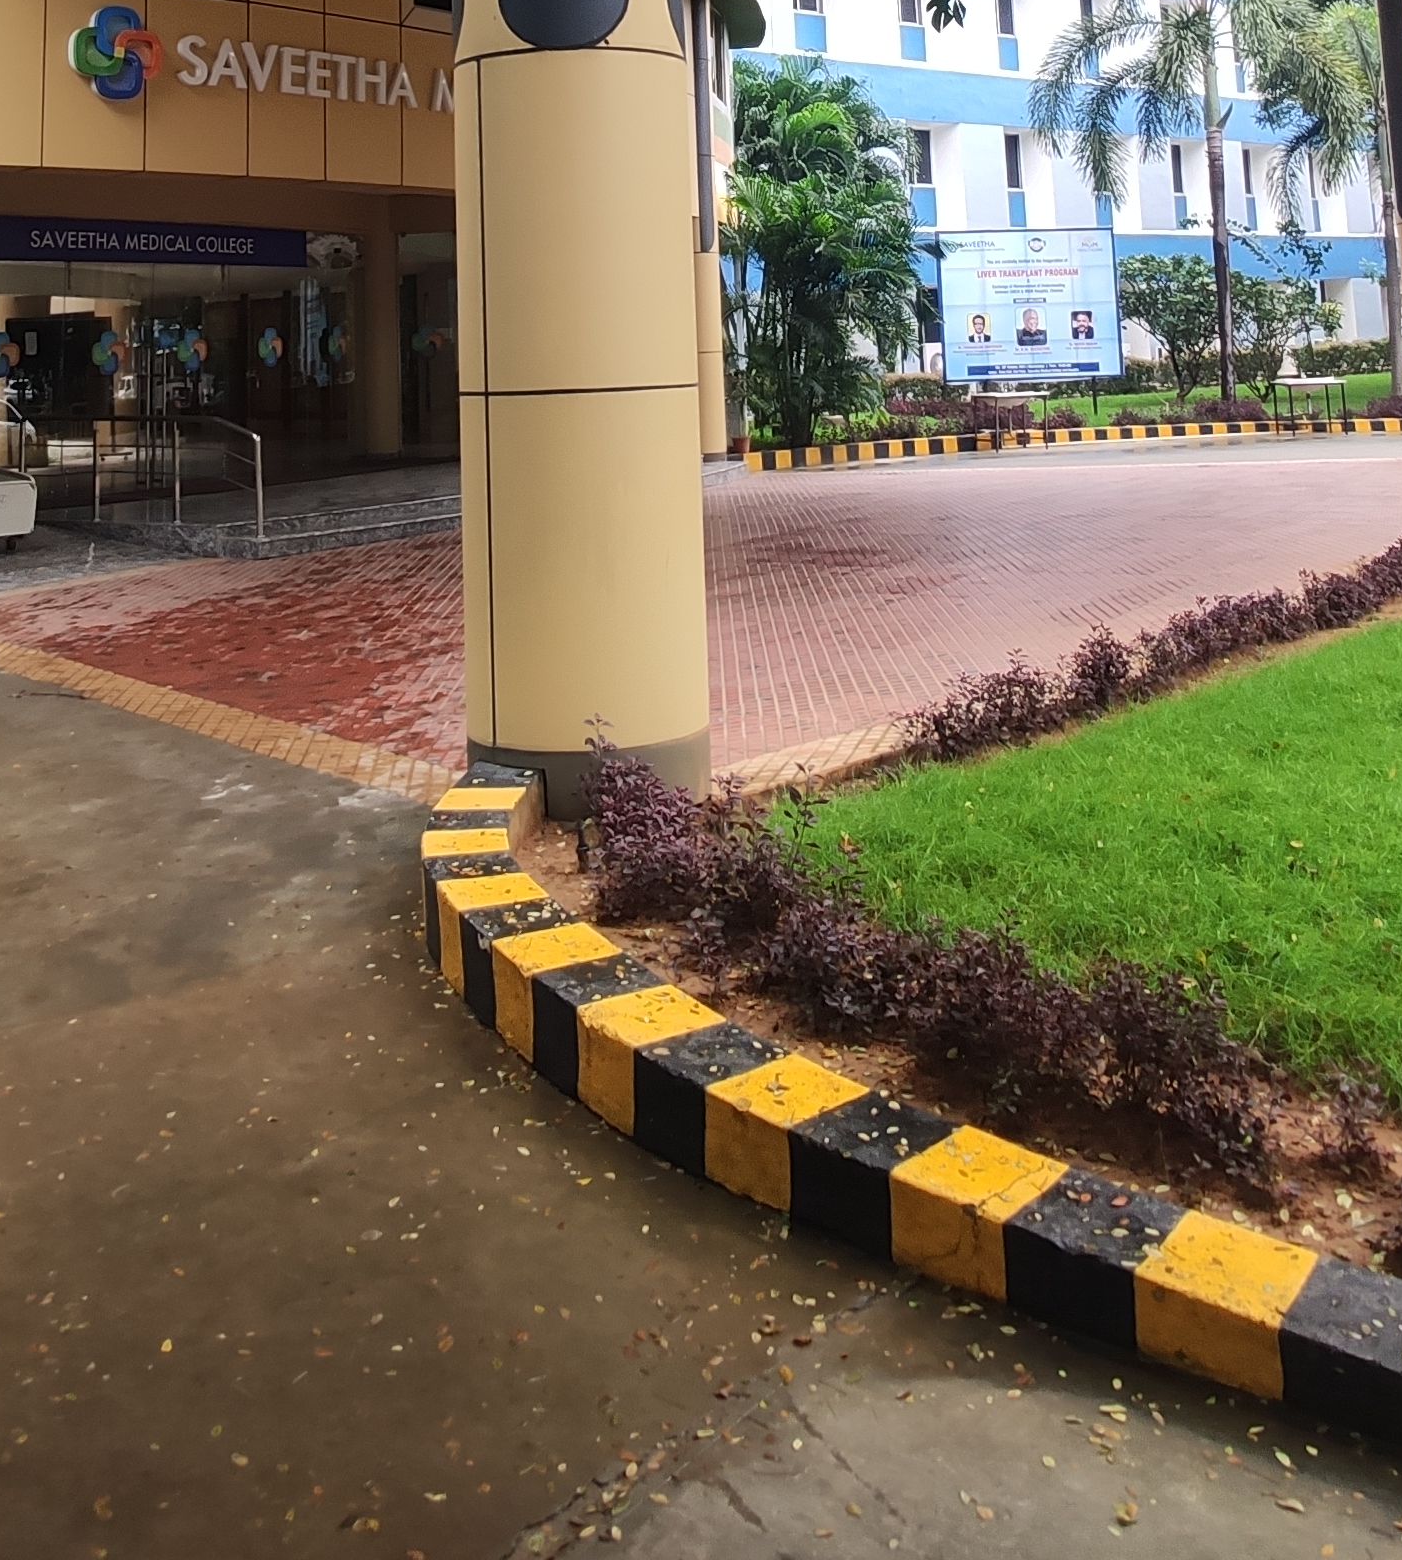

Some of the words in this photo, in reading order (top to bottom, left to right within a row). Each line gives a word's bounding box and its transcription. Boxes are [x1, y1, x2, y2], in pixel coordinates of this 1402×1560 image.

[176, 35, 418, 108] SAVEETHA
[30, 230, 120, 250] SAVEETHA
[124, 233, 192, 252] MEDICAL
[196, 236, 254, 254] COLLEGE
[977, 270, 997, 278] LIVER
[999, 269, 1042, 277] TRANSPLANT
[1044, 268, 1079, 276] PROGRAM
